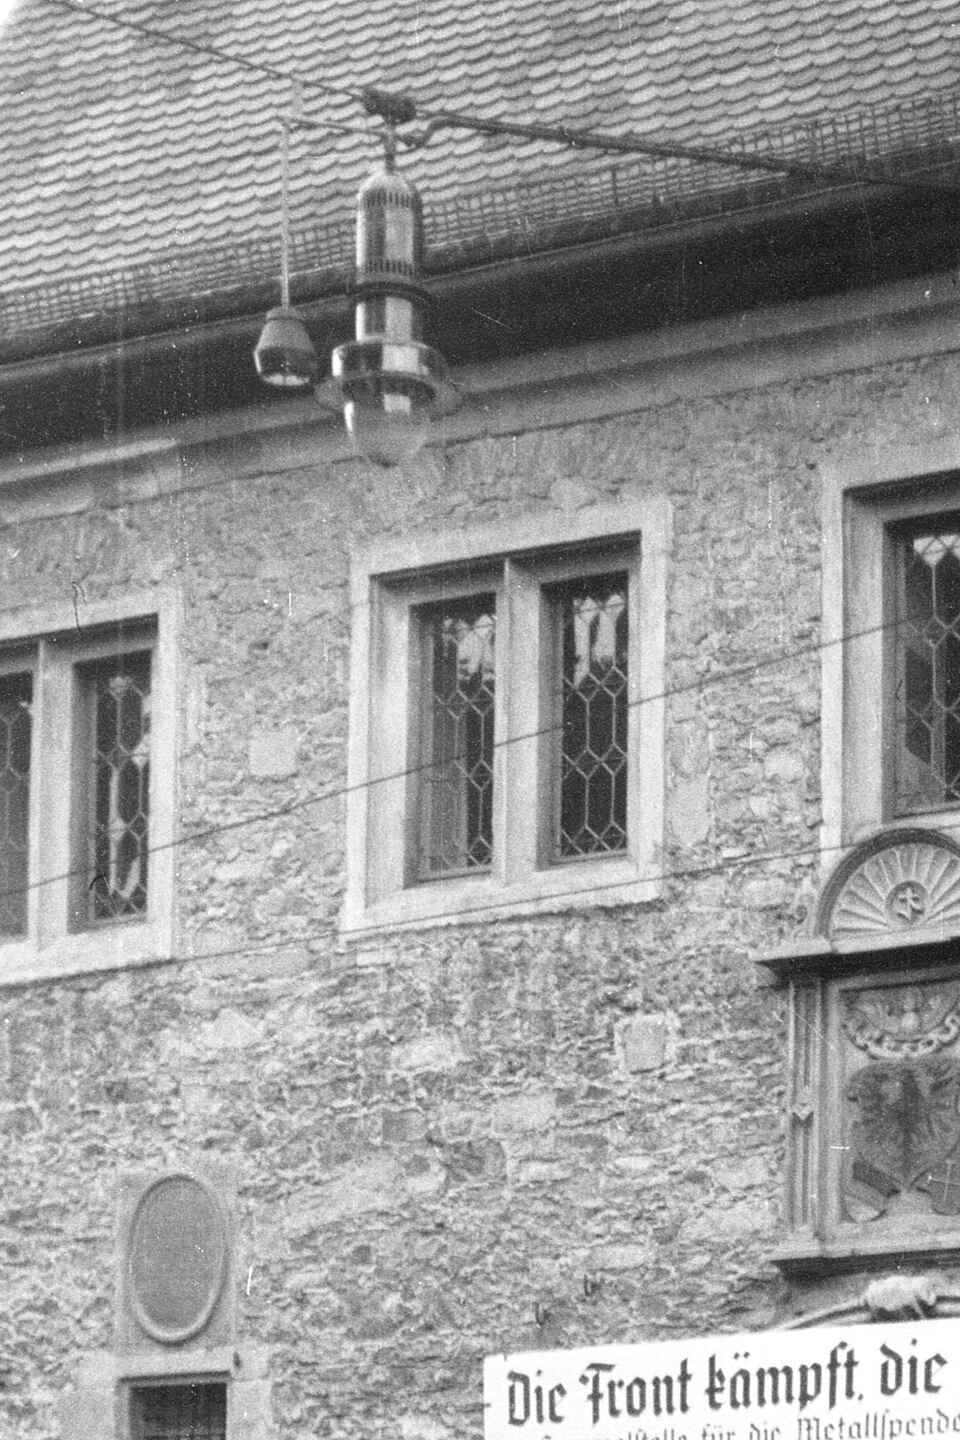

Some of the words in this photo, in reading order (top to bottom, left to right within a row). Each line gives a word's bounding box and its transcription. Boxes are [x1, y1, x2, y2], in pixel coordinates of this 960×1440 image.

[507, 1369, 567, 1426] Die
[578, 1357, 693, 1425] Front
[880, 1337, 949, 1397] die
